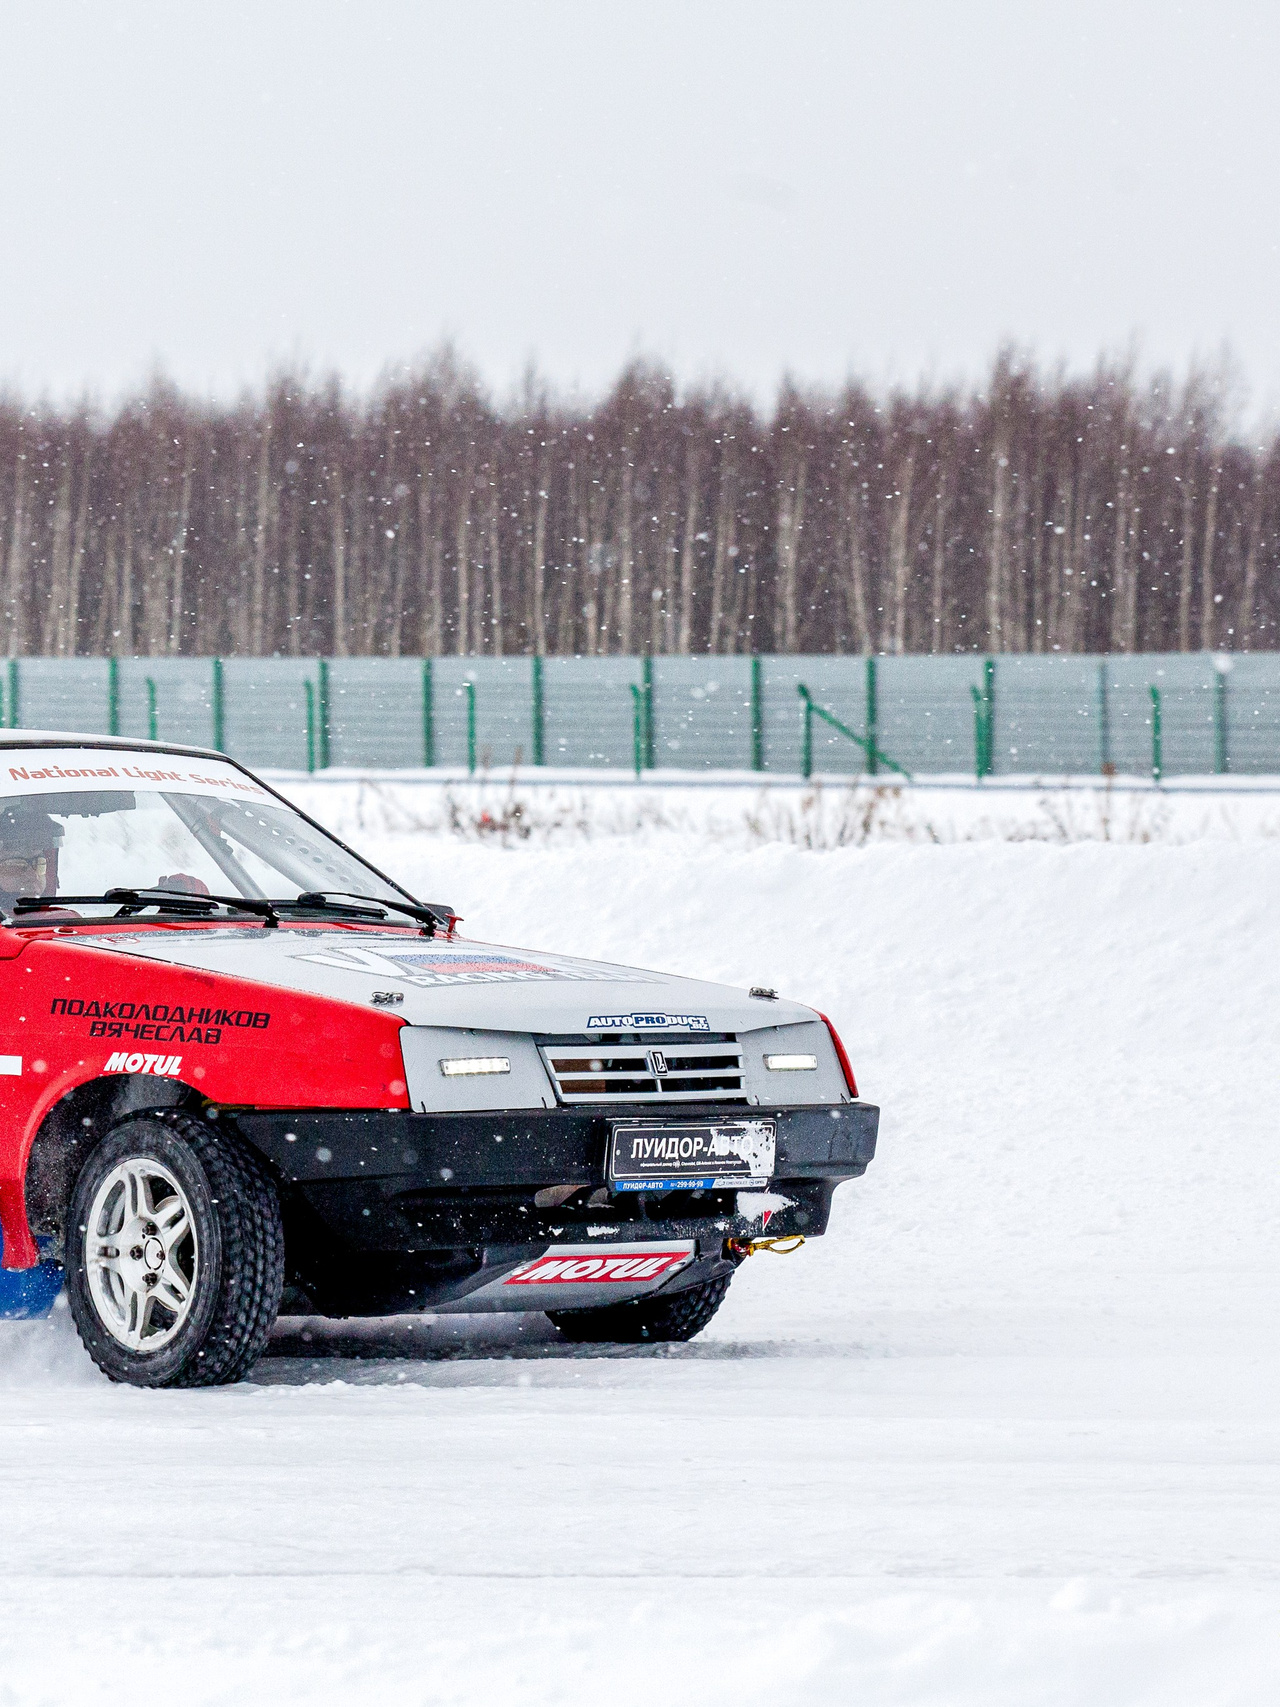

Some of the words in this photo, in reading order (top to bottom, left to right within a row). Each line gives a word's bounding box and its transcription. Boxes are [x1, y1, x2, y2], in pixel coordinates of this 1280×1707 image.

[9, 766, 118, 781] National
[125, 766, 185, 783] Light
[191, 773, 265, 796] Series
[50, 998, 271, 1030] ПОДКОЛОДНИКОВ
[89, 1021, 222, 1045] ВЯЧЕСЛАВ
[104, 1052, 183, 1076] MOTUL
[623, 1182, 663, 1190] ЛУИДОР-АВТО
[517, 1257, 673, 1281] MOTUL
